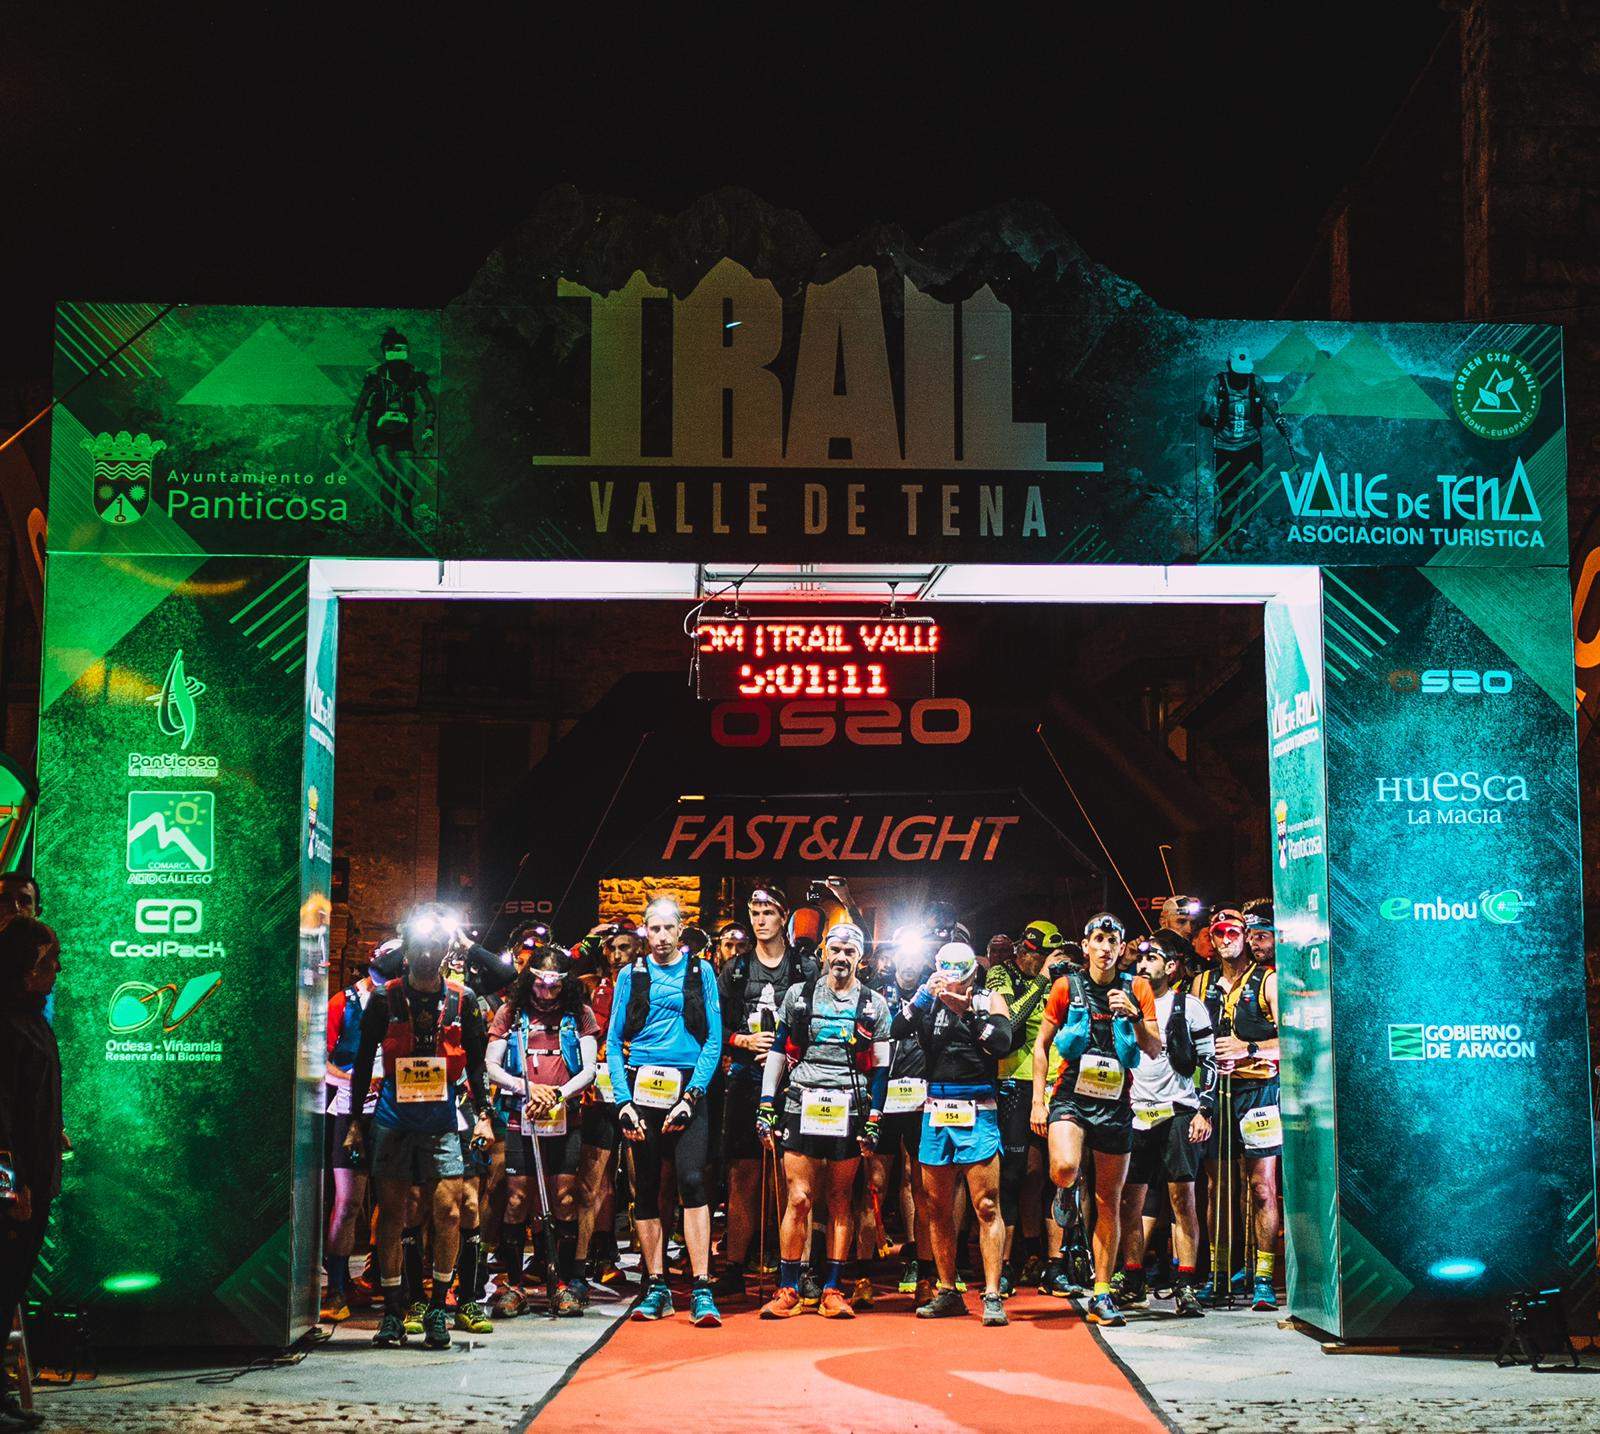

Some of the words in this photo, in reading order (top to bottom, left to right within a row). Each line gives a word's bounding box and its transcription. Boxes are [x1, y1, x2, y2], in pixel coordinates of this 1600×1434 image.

[557, 255, 1048, 466] TRAIL
[1456, 356, 1483, 391] GREEN
[1486, 352, 1510, 363] CXM
[1513, 359, 1537, 392] TRAIL
[167, 469, 315, 486] Ayuntamiento
[324, 471, 348, 486] de
[167, 489, 348, 522] Panticosa
[590, 480, 769, 534] VALLE
[803, 482, 867, 536] DE
[901, 484, 1048, 538] TENA
[1286, 524, 1424, 546] ASOCIACION
[1430, 527, 1545, 547] TURISTICA
[128, 752, 219, 769] Panticosa
[1375, 771, 1531, 802] Huesca
[661, 814, 1021, 862] FAST&LIGHT
[147, 861, 191, 870] COMARCA
[109, 940, 227, 958] CoolPack
[1424, 1024, 1522, 1041] GOBIERNO
[105, 1038, 153, 1052] Ordesa
[162, 1038, 223, 1052] Viñamala
[1426, 1042, 1452, 1059] DE
[105, 1051, 147, 1062] Reserva
[150, 1051, 163, 1061] de
[165, 1051, 175, 1061] la
[177, 1051, 222, 1062] Biosfera
[653, 1079, 663, 1087] 41
[945, 1112, 959, 1120] 154
[1146, 1110, 1160, 1118] 106
[1255, 1119, 1270, 1128] 137
